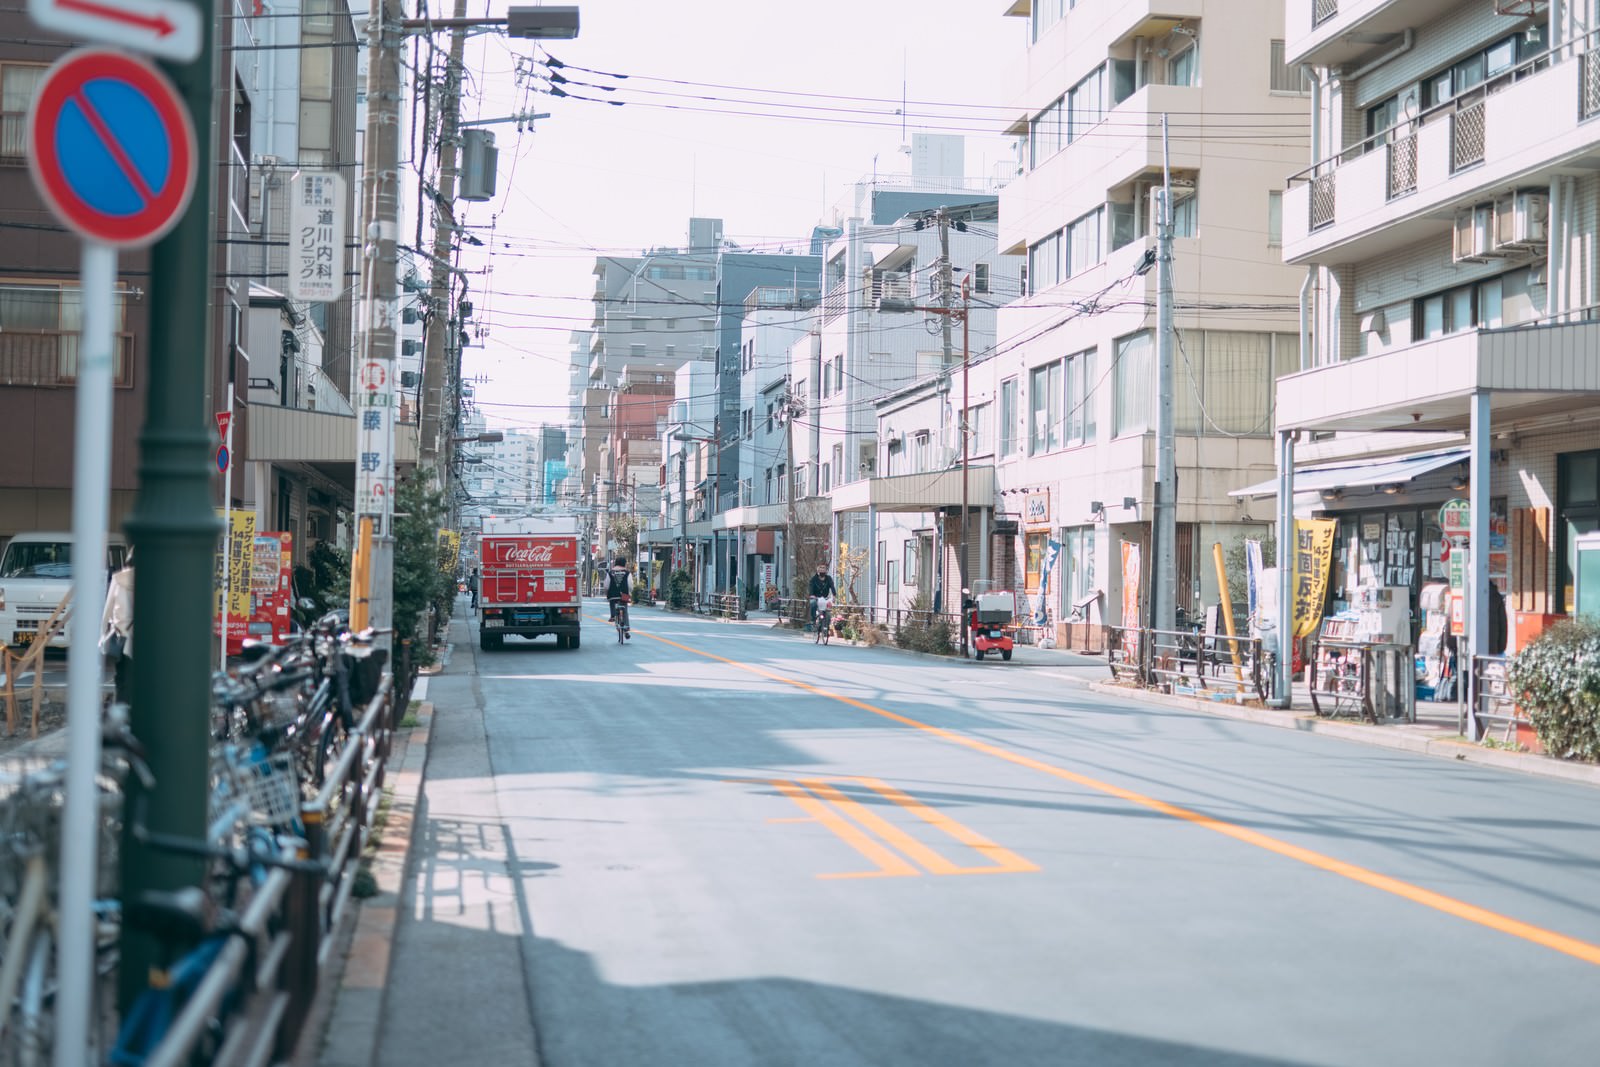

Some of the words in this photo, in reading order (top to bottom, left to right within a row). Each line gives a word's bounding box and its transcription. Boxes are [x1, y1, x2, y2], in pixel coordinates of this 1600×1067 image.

[300, 226, 315, 279] クリニック
[316, 209, 334, 280] 道川内科
[361, 410, 381, 472] 藤野
[505, 545, 554, 562] Coca-Cola
